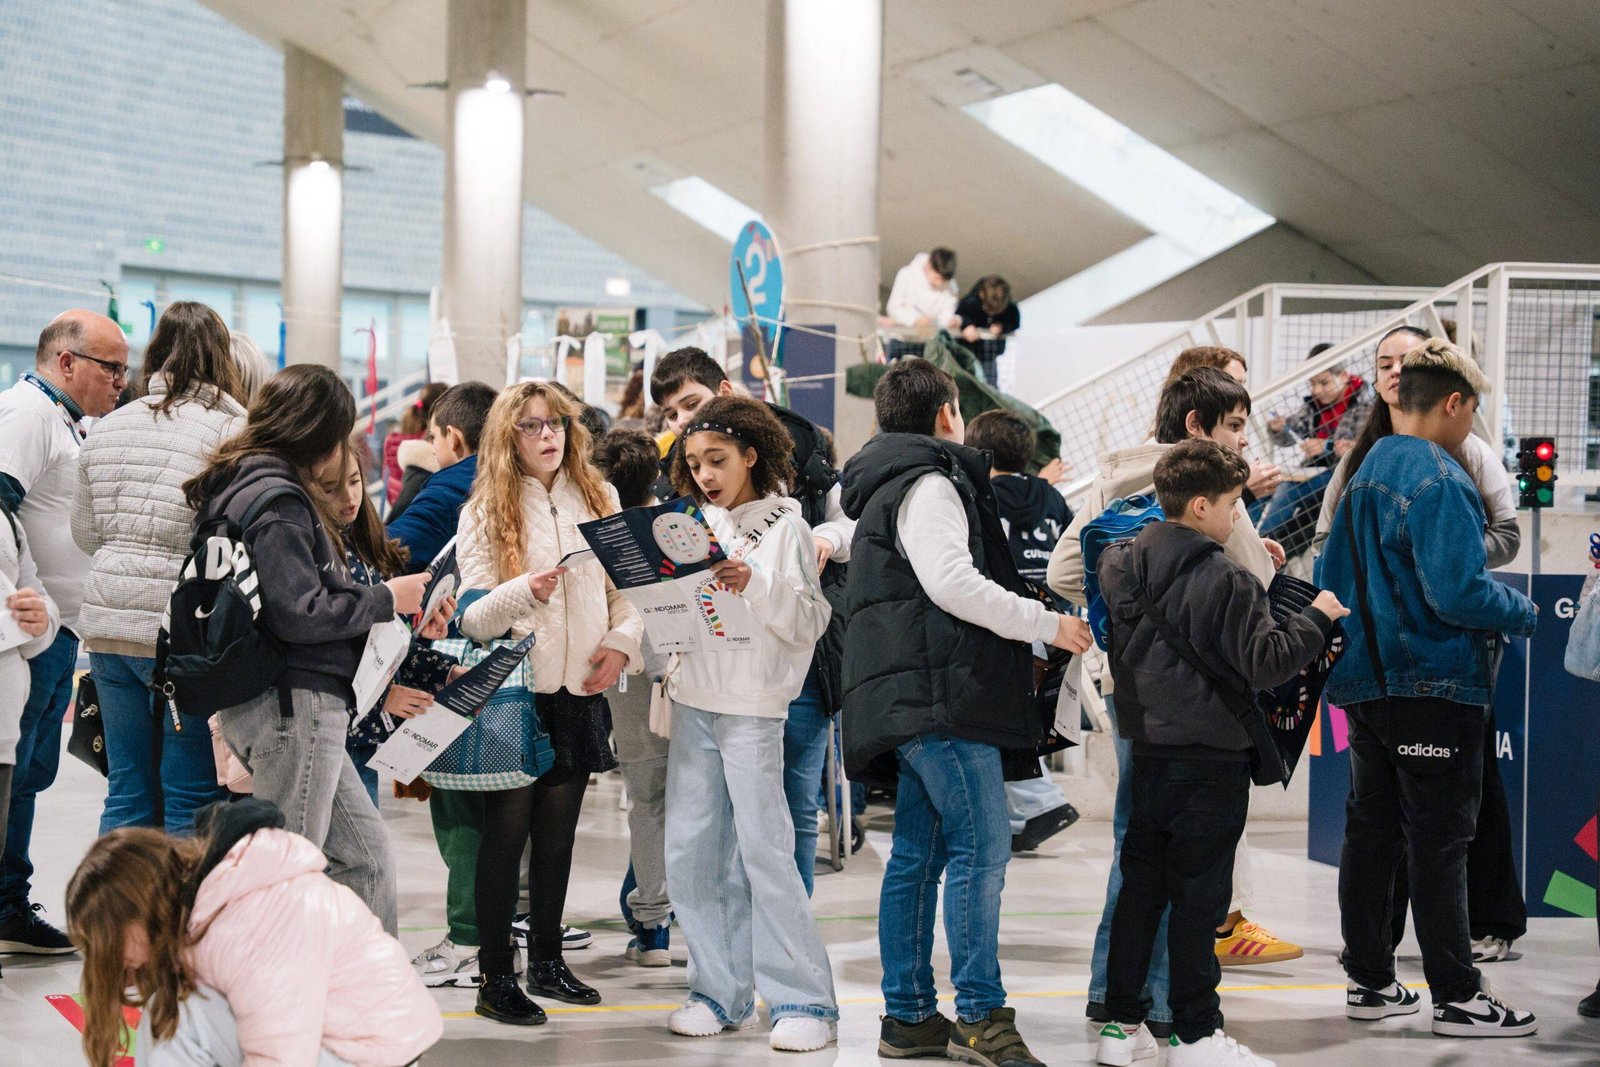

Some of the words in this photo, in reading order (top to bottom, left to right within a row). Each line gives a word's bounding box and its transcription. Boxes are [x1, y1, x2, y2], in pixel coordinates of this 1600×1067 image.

[745, 242, 767, 305] 2
[700, 576, 717, 586] CIDA
[644, 603, 687, 613] GNDOMAR
[403, 728, 438, 750] GNDOMAR
[1398, 743, 1450, 758] adidas
